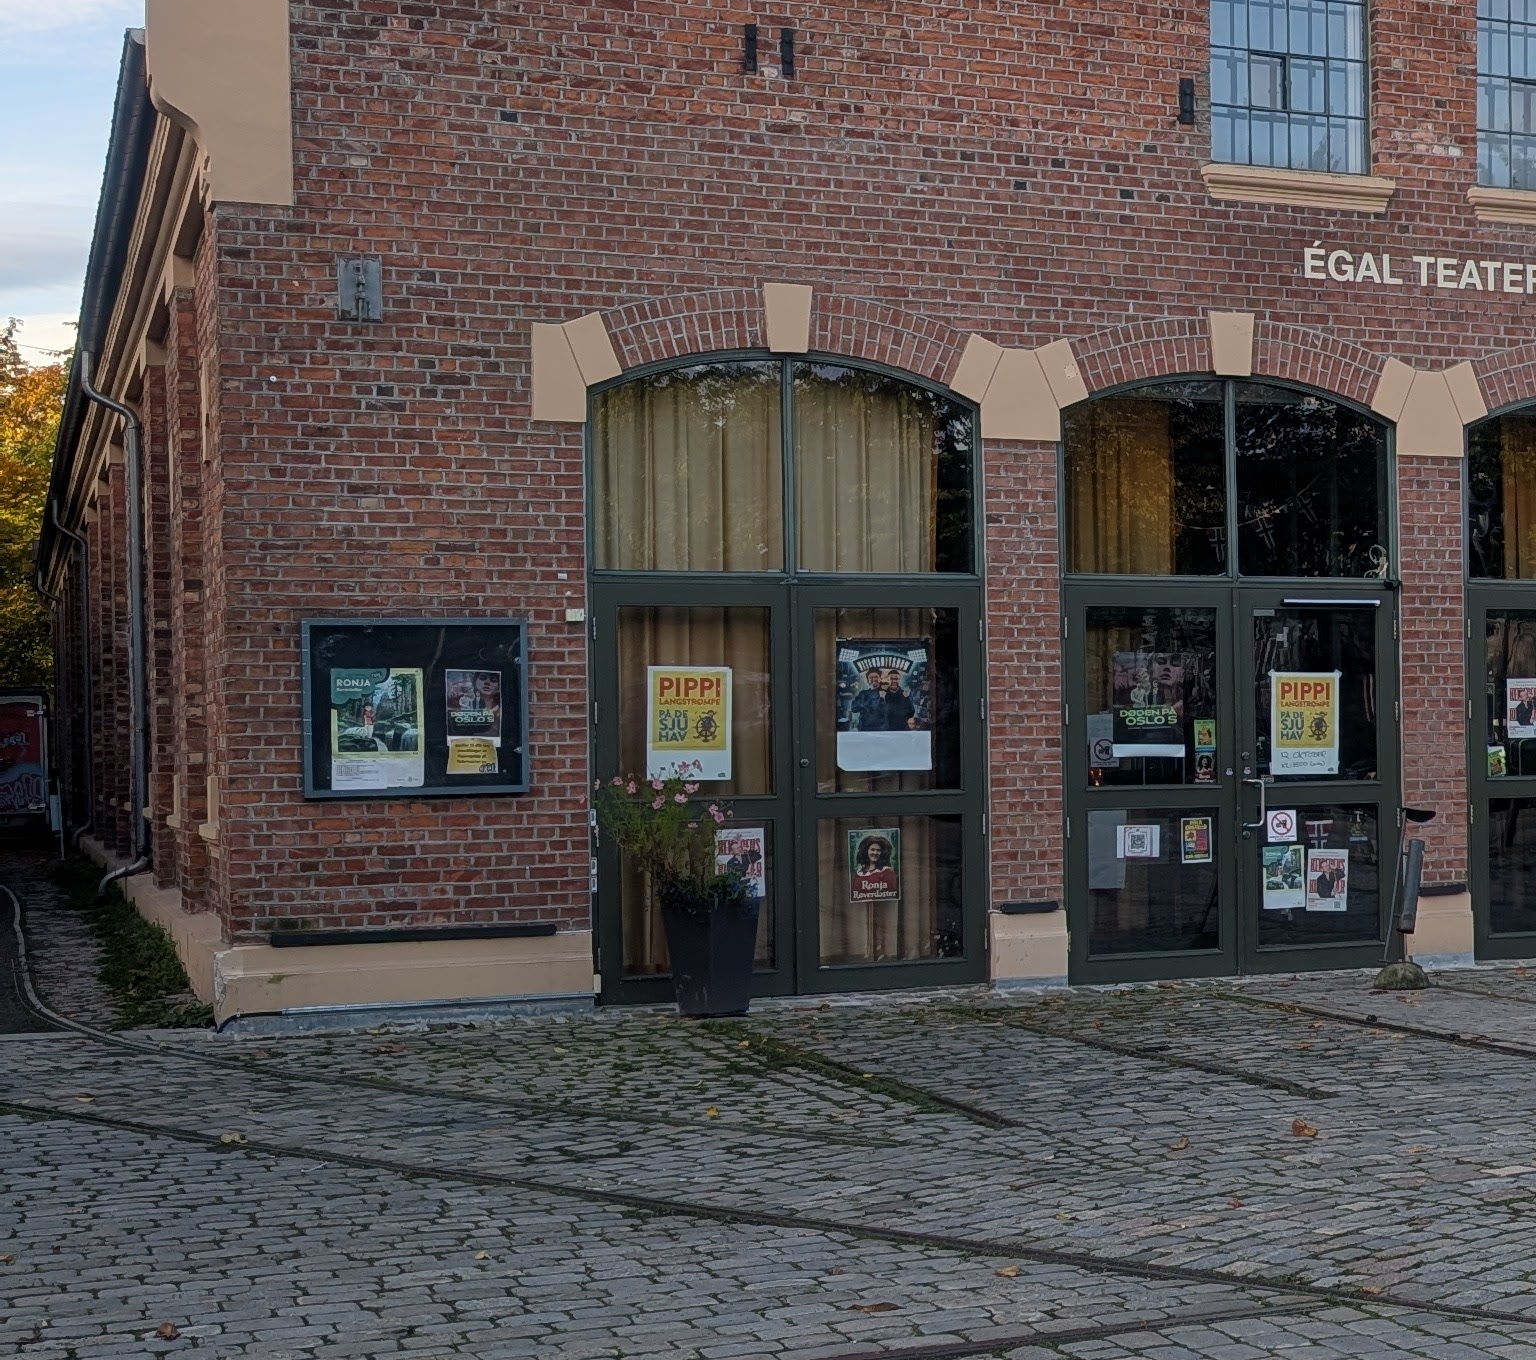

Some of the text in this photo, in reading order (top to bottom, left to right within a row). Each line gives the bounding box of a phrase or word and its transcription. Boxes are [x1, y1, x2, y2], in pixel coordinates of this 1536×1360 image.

[1303, 240, 1403, 284] ÉGAL
[336, 679, 371, 687] RONJA
[659, 677, 721, 698] PIPPI
[1280, 682, 1330, 700] PIPPI
[674, 709, 689, 718] DE
[1119, 709, 1160, 718] DØDEN
[659, 718, 689, 731] SJU
[1125, 715, 1178, 726] OSLO S
[1281, 719, 1305, 731] SJU
[658, 731, 688, 742] HAV
[1281, 730, 1305, 740] HAV
[861, 880, 888, 890] Ronja
